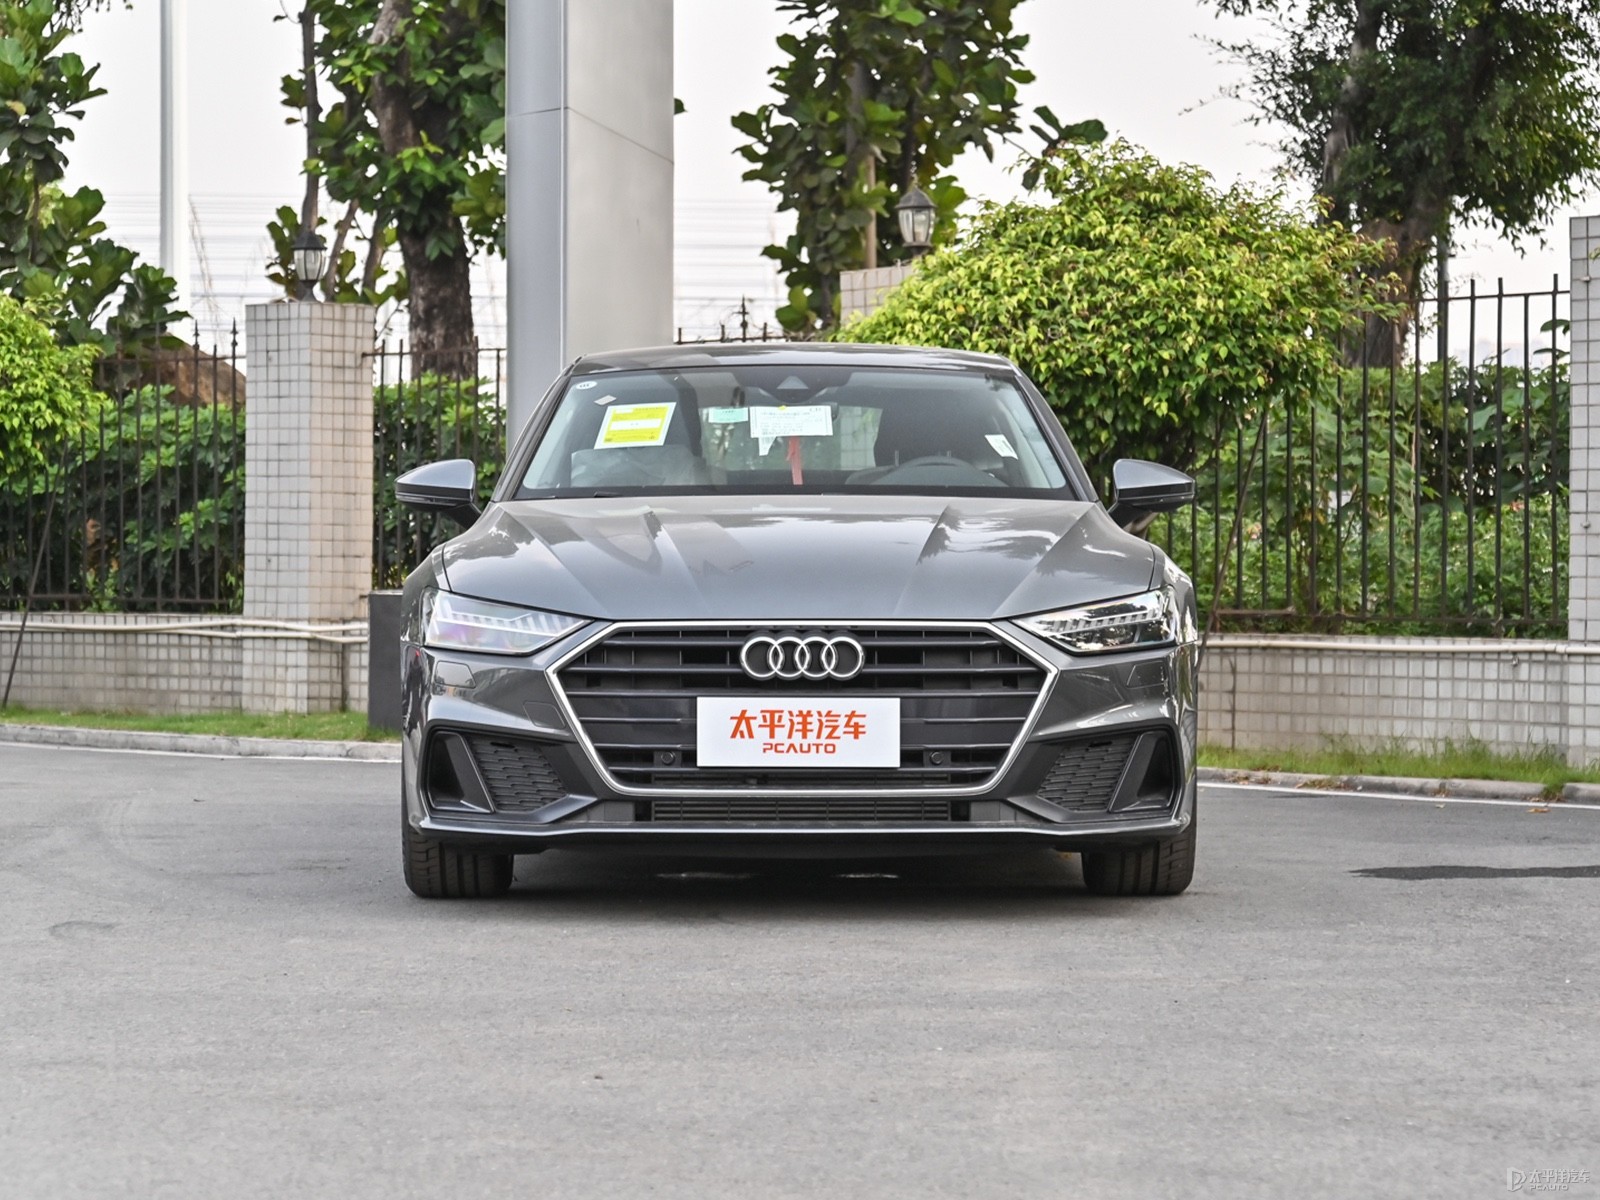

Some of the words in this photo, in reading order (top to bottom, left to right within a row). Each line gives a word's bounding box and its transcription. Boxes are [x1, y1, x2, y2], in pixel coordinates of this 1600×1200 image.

[729, 709, 867, 740] 太平洋汽车
[762, 742, 836, 754] PCAUTO
